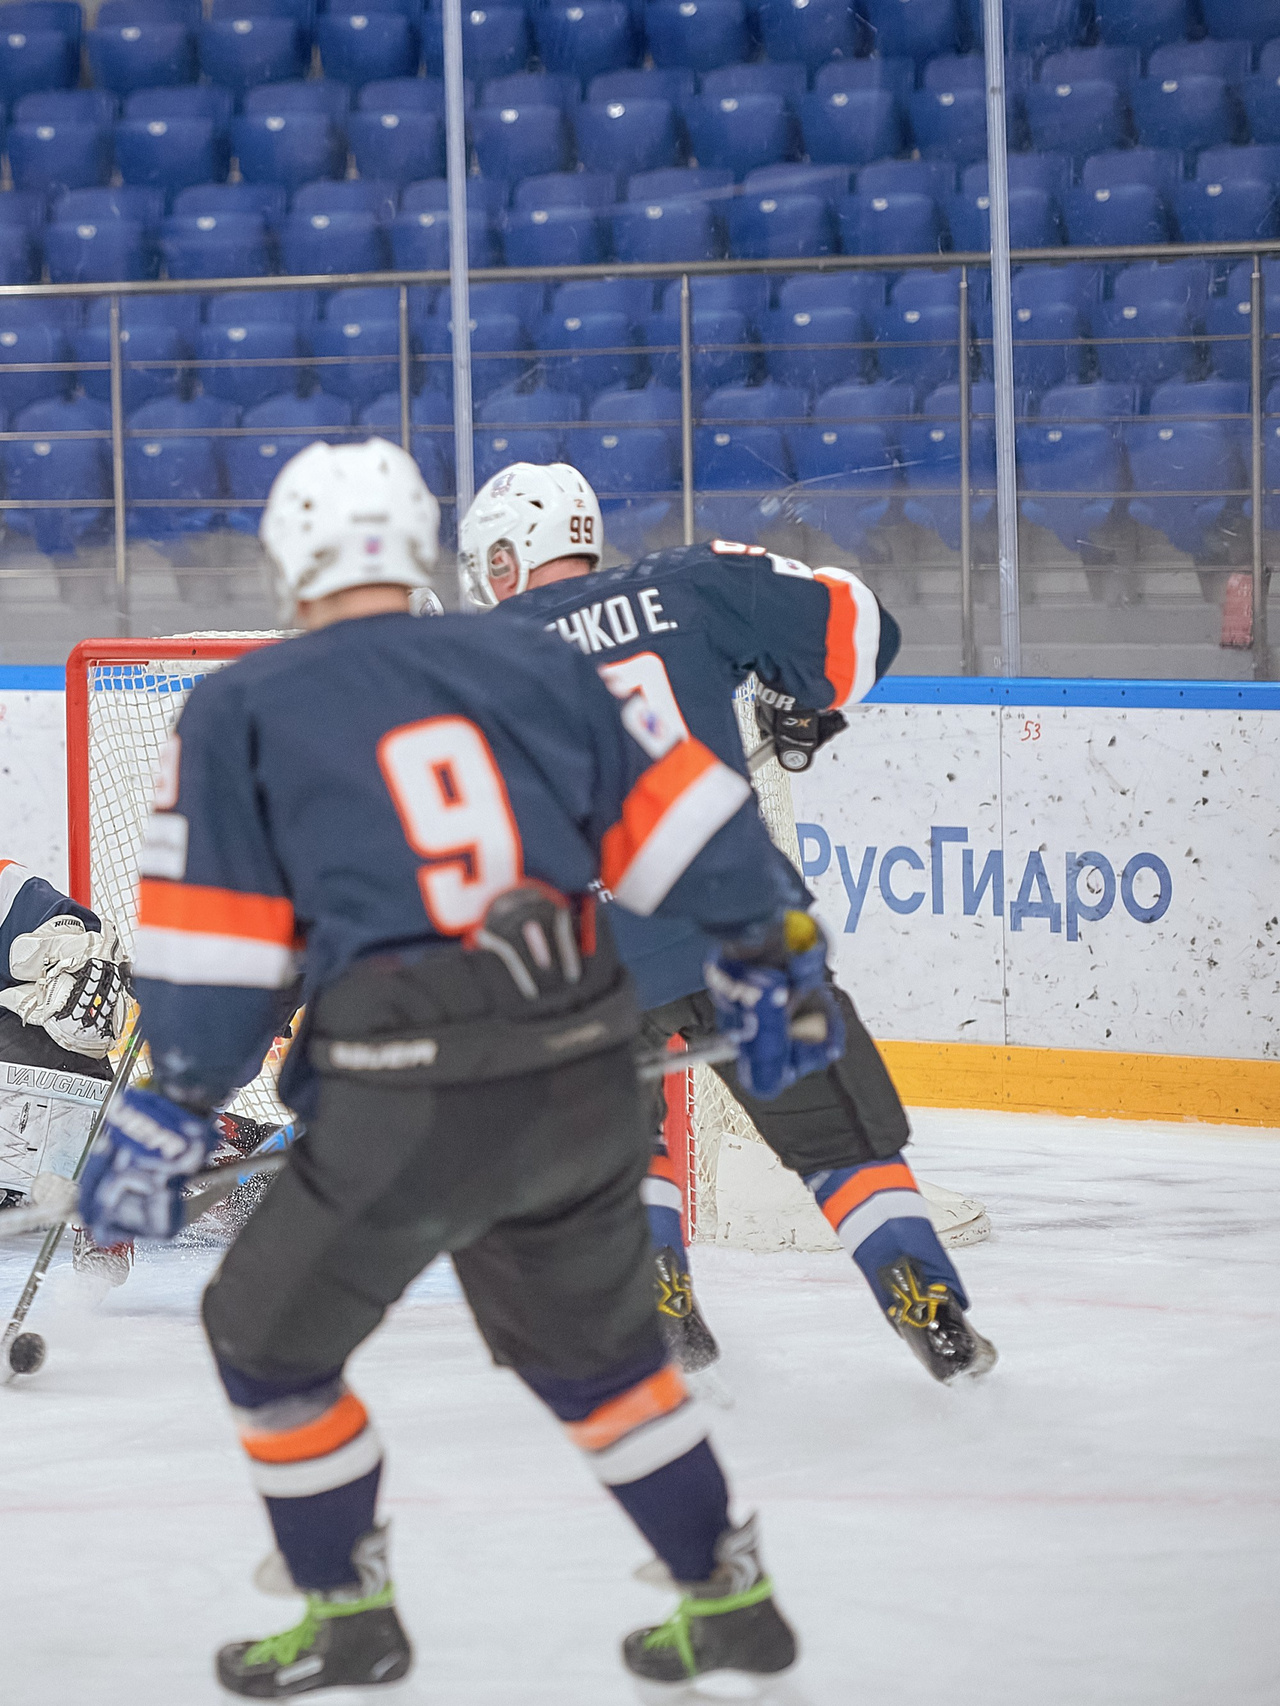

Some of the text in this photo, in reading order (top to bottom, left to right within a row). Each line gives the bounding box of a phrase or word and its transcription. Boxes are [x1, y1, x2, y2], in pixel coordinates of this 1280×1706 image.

[570, 515, 594, 544] 99
[757, 681, 796, 711] IOR
[1021, 720, 1041, 741] 53
[375, 713, 525, 937] 9
[796, 822, 1173, 942] РусГидро
[6, 1065, 110, 1102] VAUGHN
